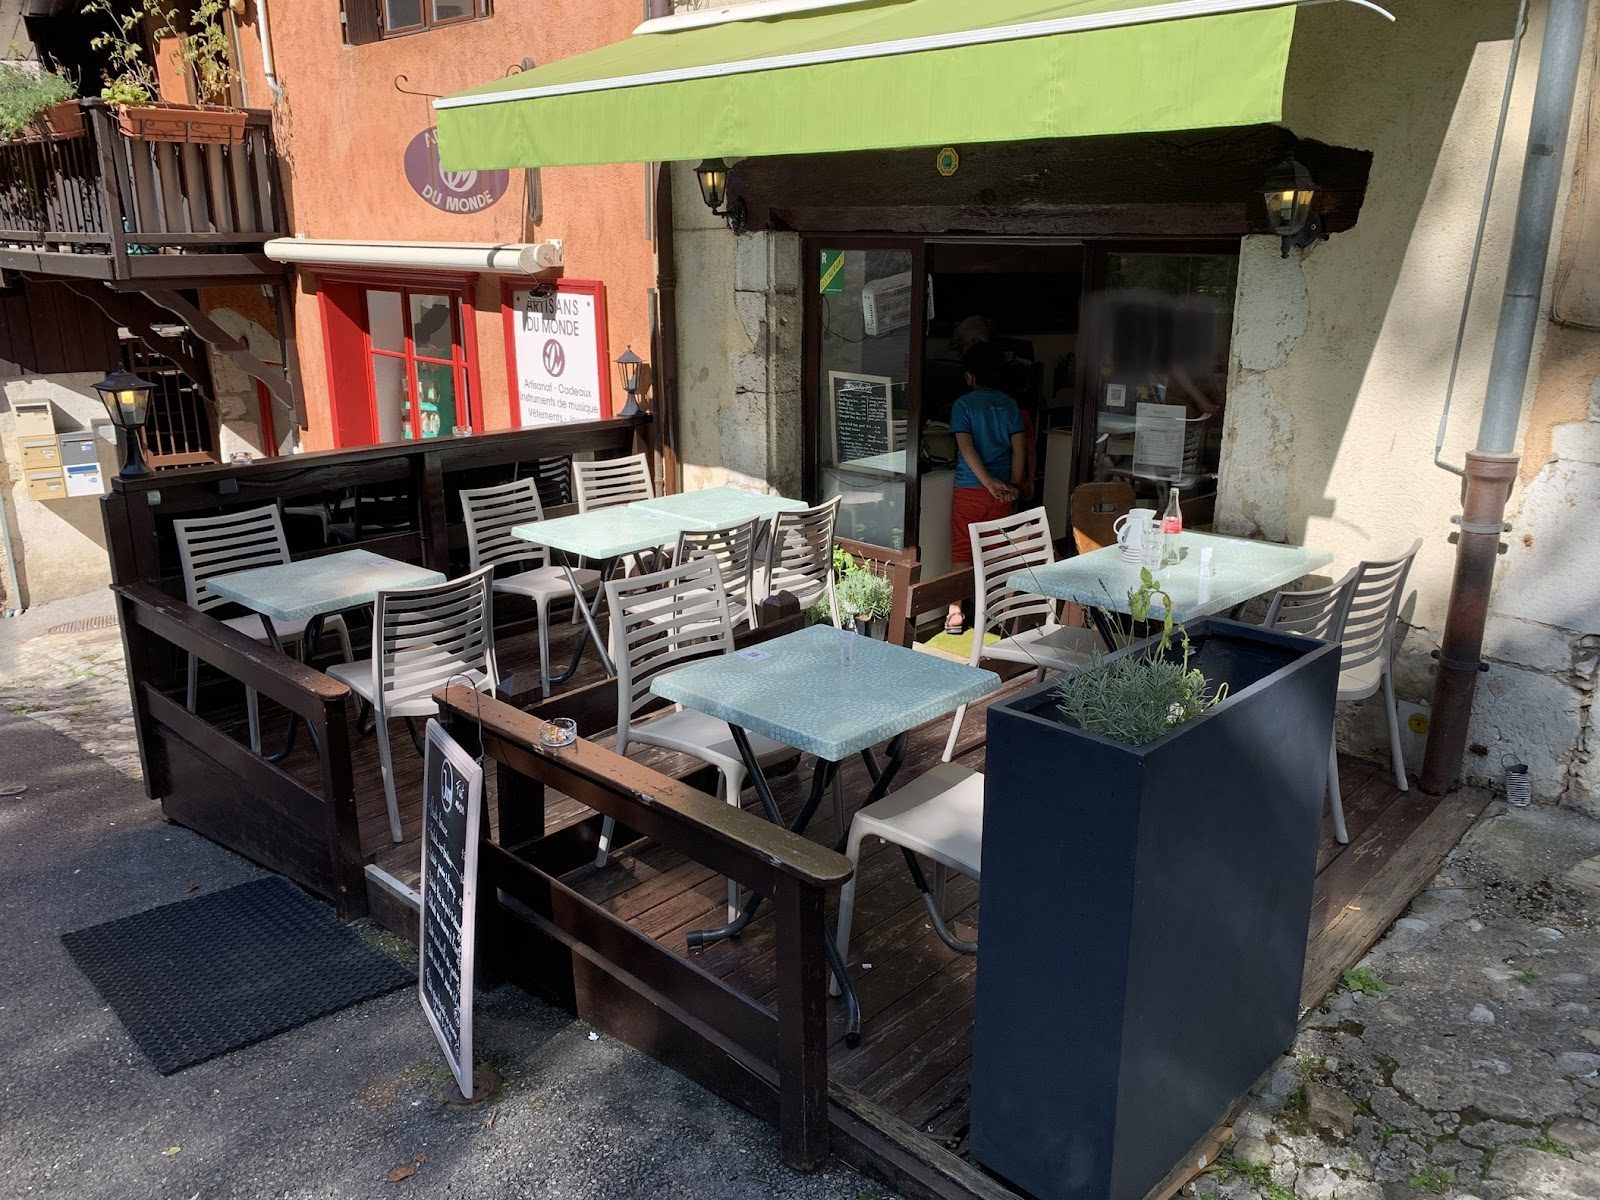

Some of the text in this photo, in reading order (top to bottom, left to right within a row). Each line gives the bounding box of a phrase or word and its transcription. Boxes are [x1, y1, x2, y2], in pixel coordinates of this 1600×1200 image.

[422, 184, 494, 212] DU MONDE
[527, 298, 579, 316] ARTISANS
[527, 316, 580, 337] DU MONDE
[524, 378, 553, 392] Artisanat
[558, 383, 592, 398] Cadeaux
[557, 399, 567, 409] de
[568, 401, 599, 415] musique
